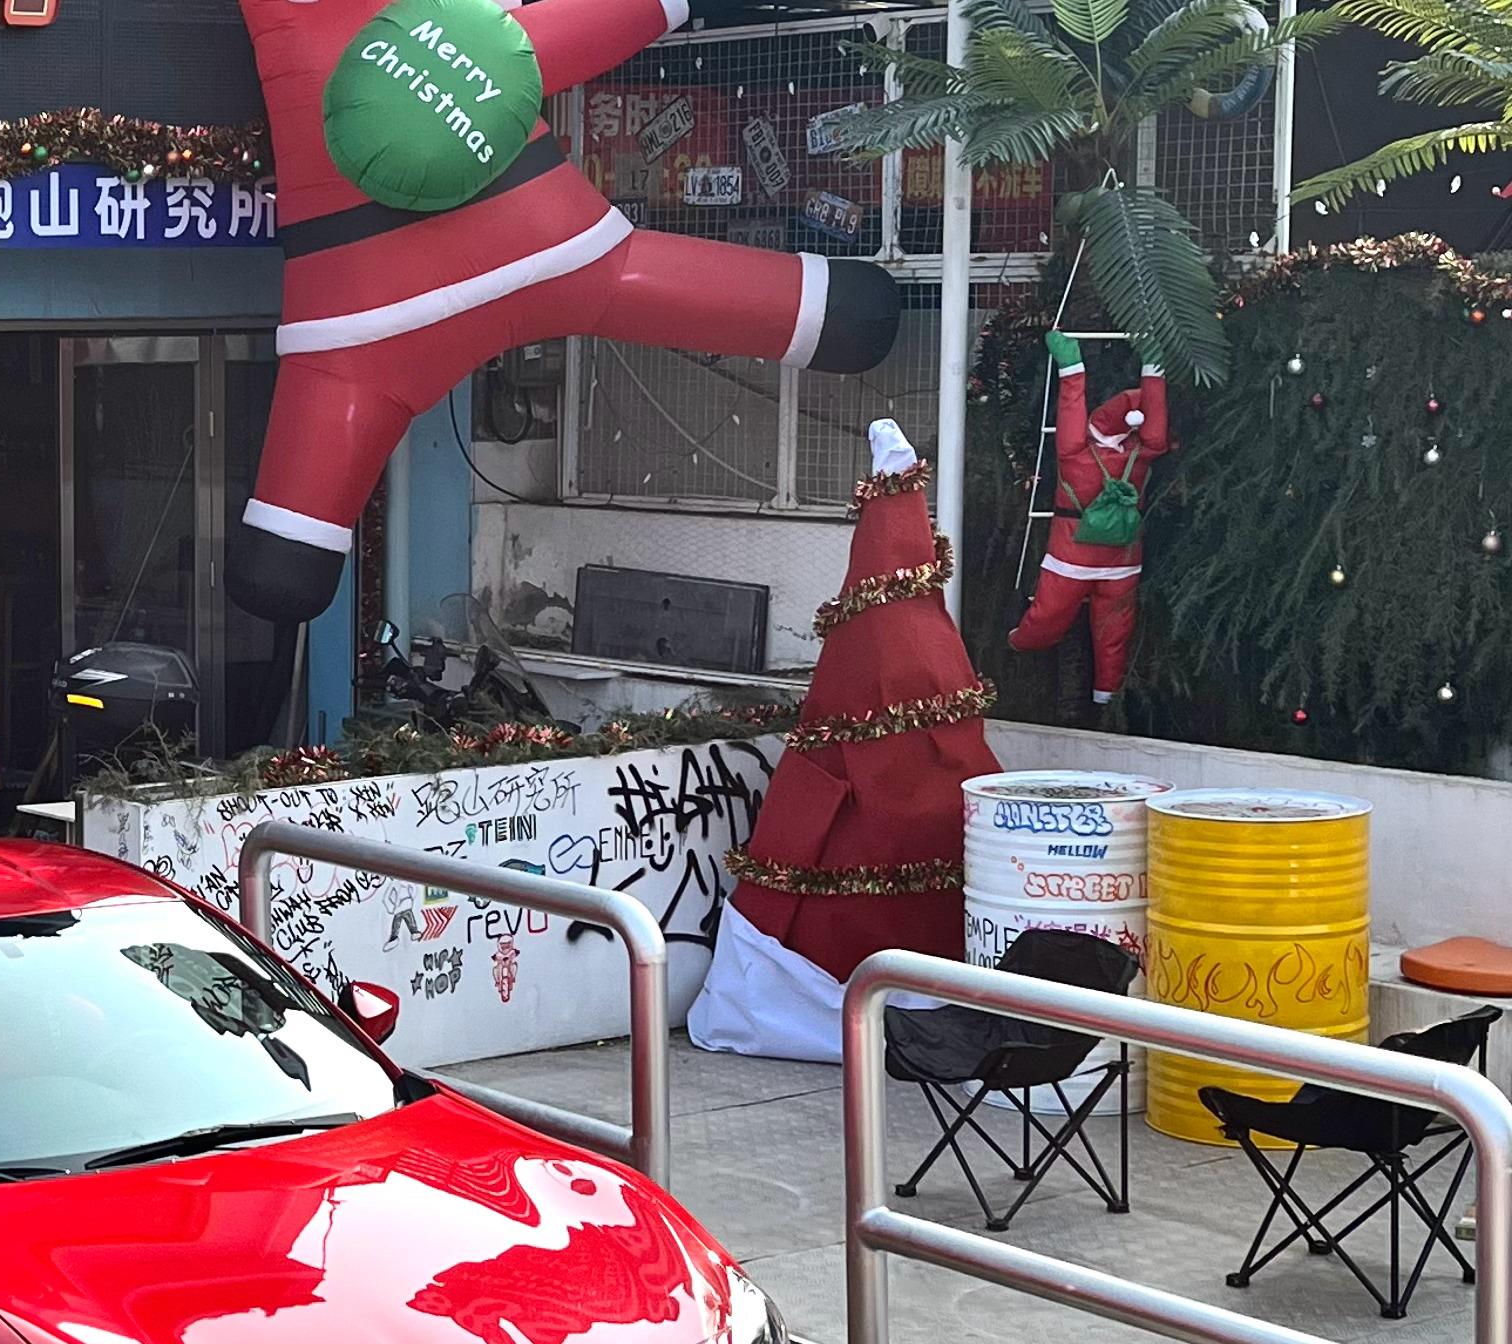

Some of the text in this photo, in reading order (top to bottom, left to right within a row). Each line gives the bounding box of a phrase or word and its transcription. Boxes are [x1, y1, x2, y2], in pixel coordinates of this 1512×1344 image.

[360, 39, 495, 164] Christmas
[409, 20, 502, 103] Merry
[1047, 844, 1109, 859] MELLOW
